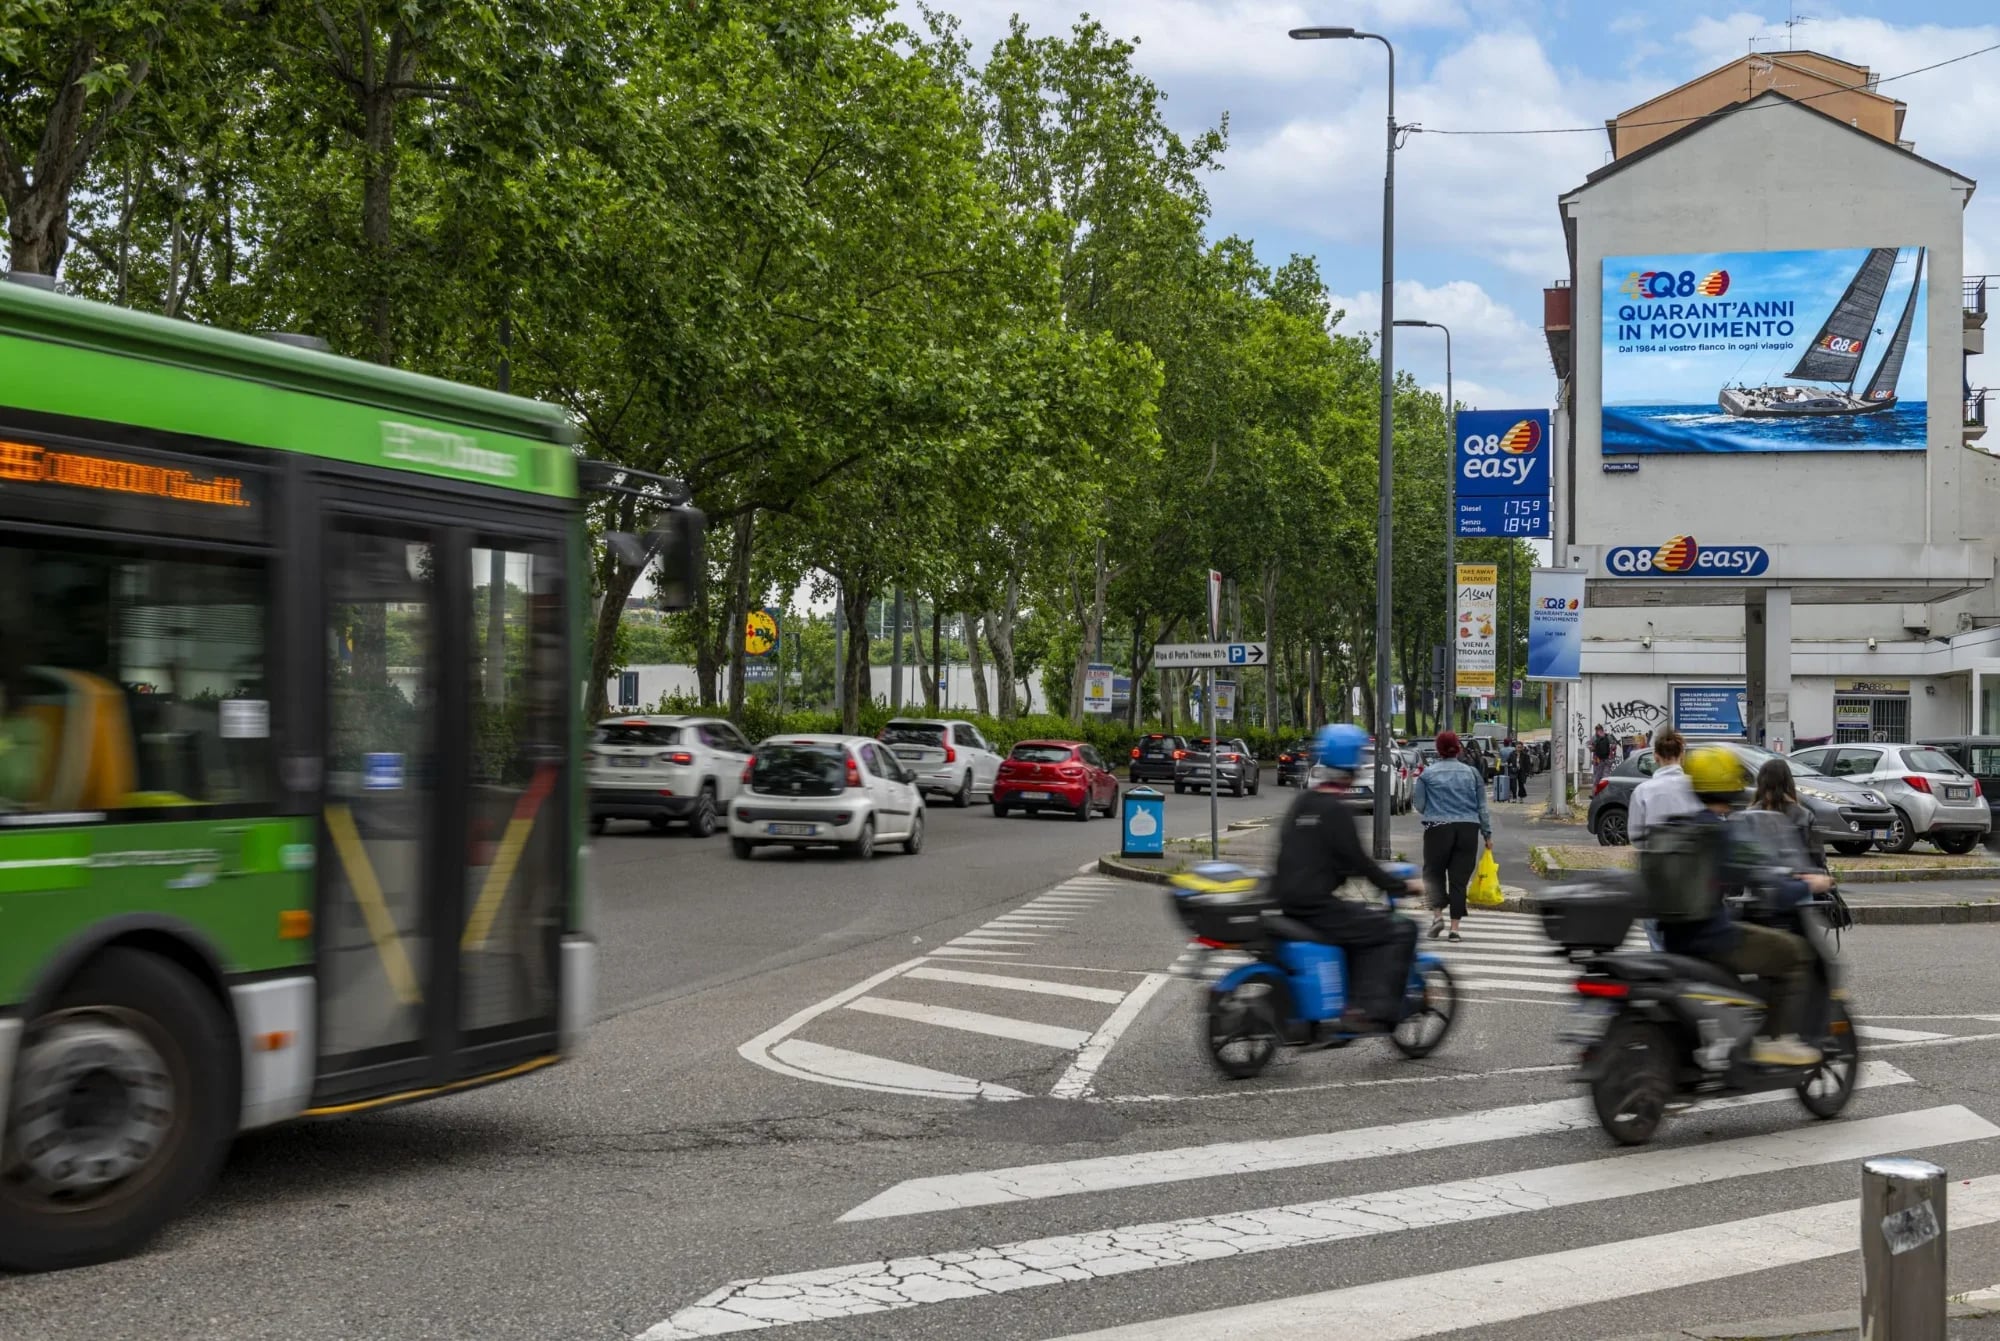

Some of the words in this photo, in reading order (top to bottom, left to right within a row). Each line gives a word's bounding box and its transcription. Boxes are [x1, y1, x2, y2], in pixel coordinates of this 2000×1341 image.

[1618, 300, 1795, 322] QUARANT'ANNI
[1618, 323, 1642, 341] IN
[1651, 320, 1795, 340] MOVIMENTO
[1618, 344, 1634, 353] Dal
[1635, 344, 1656, 353] 1984
[1658, 343, 1667, 352] al
[1668, 343, 1696, 352] vostro
[1698, 342, 1725, 351] fianco
[1728, 342, 1736, 351] in
[1738, 342, 1758, 353] ogni
[1760, 341, 1794, 352] viaggio
[1463, 434, 1500, 456] Q8
[1463, 457, 1537, 485] easy
[1460, 504, 1482, 512] Diesel
[1460, 518, 1481, 526] Senza
[1460, 525, 1487, 533] Piombo
[1612, 549, 1652, 573] Q8
[1697, 550, 1761, 574] easy
[1838, 706, 1869, 714] FABBRO
